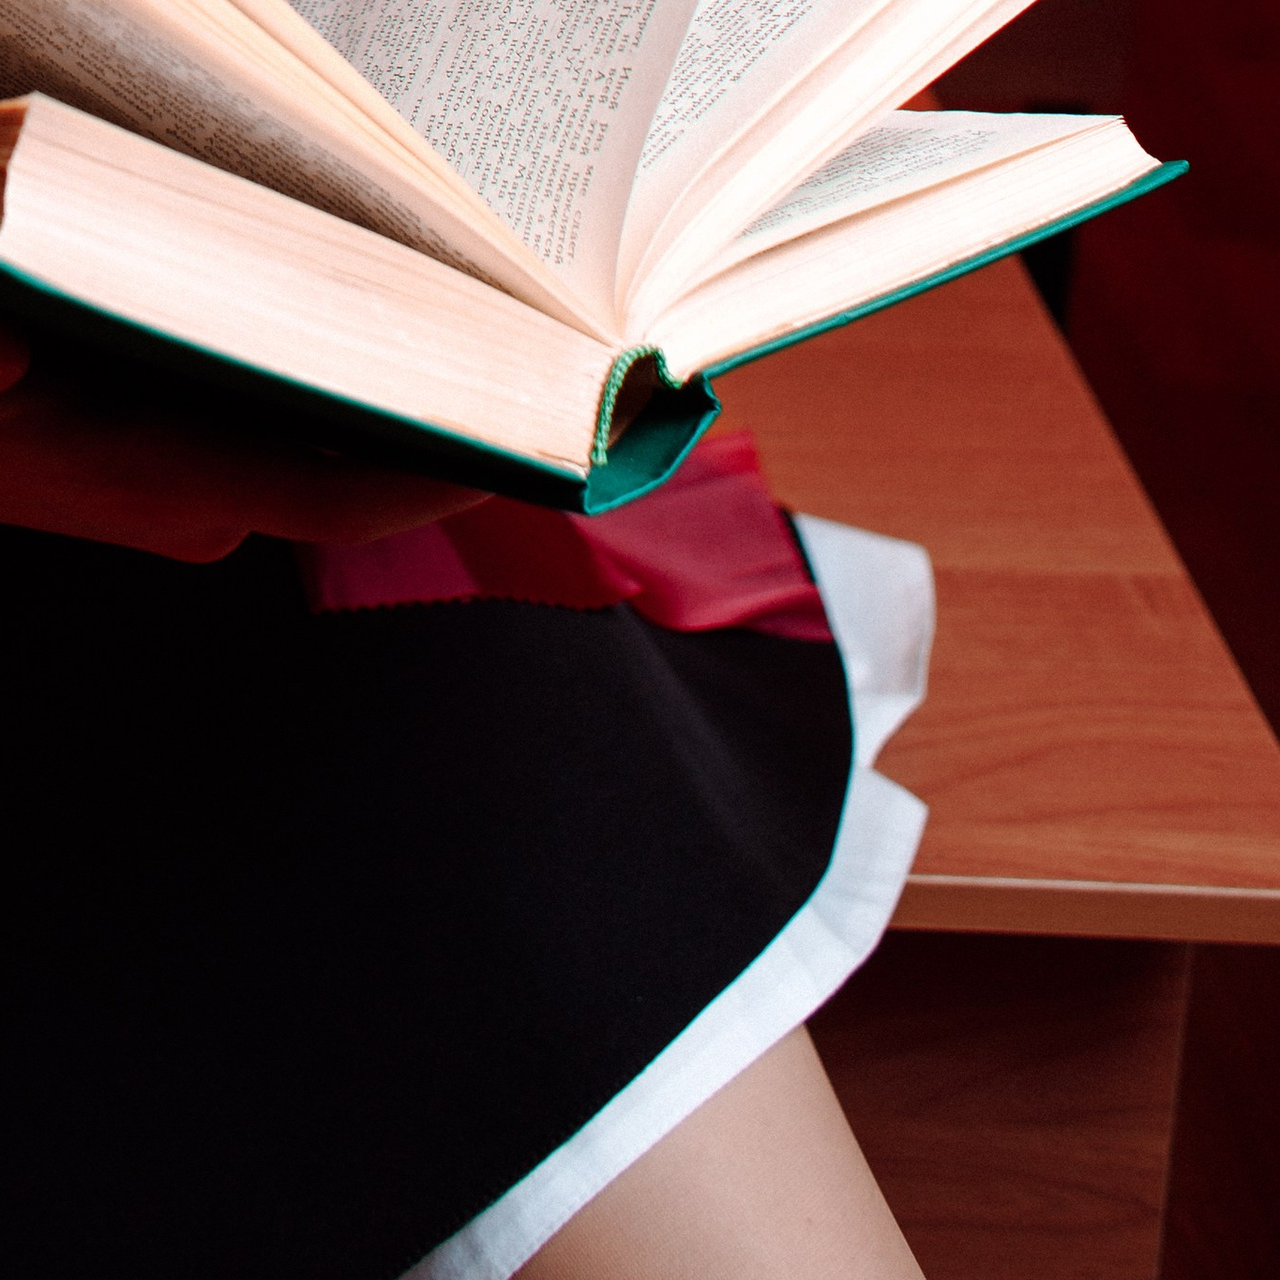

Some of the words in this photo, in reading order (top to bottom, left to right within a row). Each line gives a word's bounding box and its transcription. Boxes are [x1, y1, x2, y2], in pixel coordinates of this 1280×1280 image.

[403, 3, 438, 62] опуская
[421, 5, 447, 45] через
[478, 22, 493, 42] ли
[497, 19, 519, 46] Так
[581, 14, 606, 47] бог,
[600, 4, 632, 57] Пусто.
[615, 33, 631, 53] на
[419, 39, 450, 89] шоссе,
[442, 24, 474, 79] доллар
[462, 51, 481, 75] ты,
[482, 42, 495, 59] от
[499, 14, 539, 89] лоскутки,
[502, 38, 519, 63] нее
[537, 38, 551, 56] не
[538, 49, 557, 79] мне
[561, 46, 581, 72] Тут
[432, 28, 481, 130] шестнадцать
[479, 55, 501, 85] вот,
[488, 18, 552, 148] калейдоскопами
[489, 72, 505, 90] на
[511, 66, 540, 111] знаю,
[542, 68, 559, 96] что
[568, 57, 586, 83] тут
[575, 67, 593, 98] сам
[597, 67, 620, 104] всей
[606, 65, 633, 110] Иной
[451, 85, 467, 112] что
[460, 70, 484, 108] него,
[549, 88, 564, 107] не
[465, 99, 493, 156] солнце
[468, 96, 483, 122] это
[504, 88, 541, 167] подарили
[547, 93, 573, 143] самое
[565, 93, 596, 151] иногда
[438, 122, 454, 148] вот
[469, 103, 504, 175] бусинки,
[521, 106, 546, 152] такое
[578, 119, 601, 156] этой
[589, 122, 609, 152] раз
[487, 121, 516, 185] держал
[496, 179, 509, 199] на
[502, 163, 527, 219] Марс?
[508, 122, 551, 230] задремлешь,
[578, 164, 594, 196] мне
[551, 171, 582, 265] проклятой
